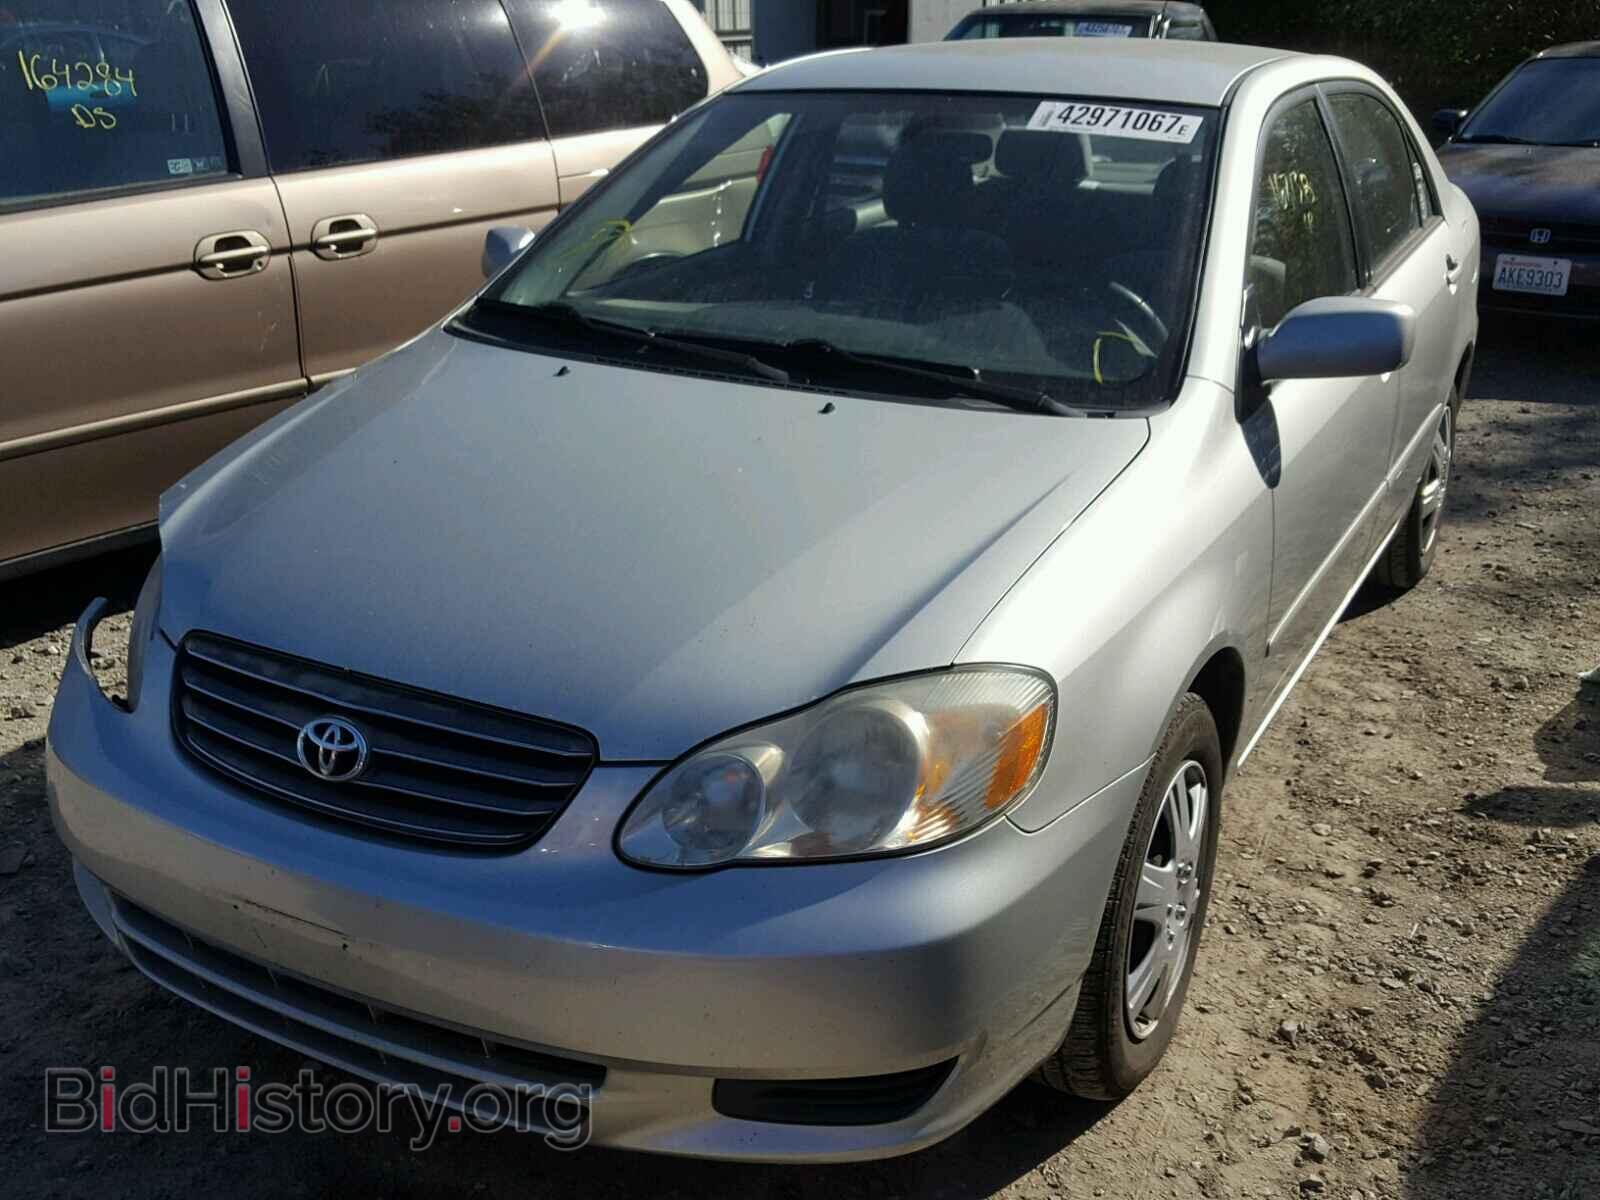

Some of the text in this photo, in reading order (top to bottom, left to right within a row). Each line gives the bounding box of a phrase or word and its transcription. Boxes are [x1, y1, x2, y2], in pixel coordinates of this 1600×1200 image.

[18, 50, 138, 97] 164284
[1057, 104, 1182, 134] 42971067
[1498, 267, 1563, 289] AKE9303
